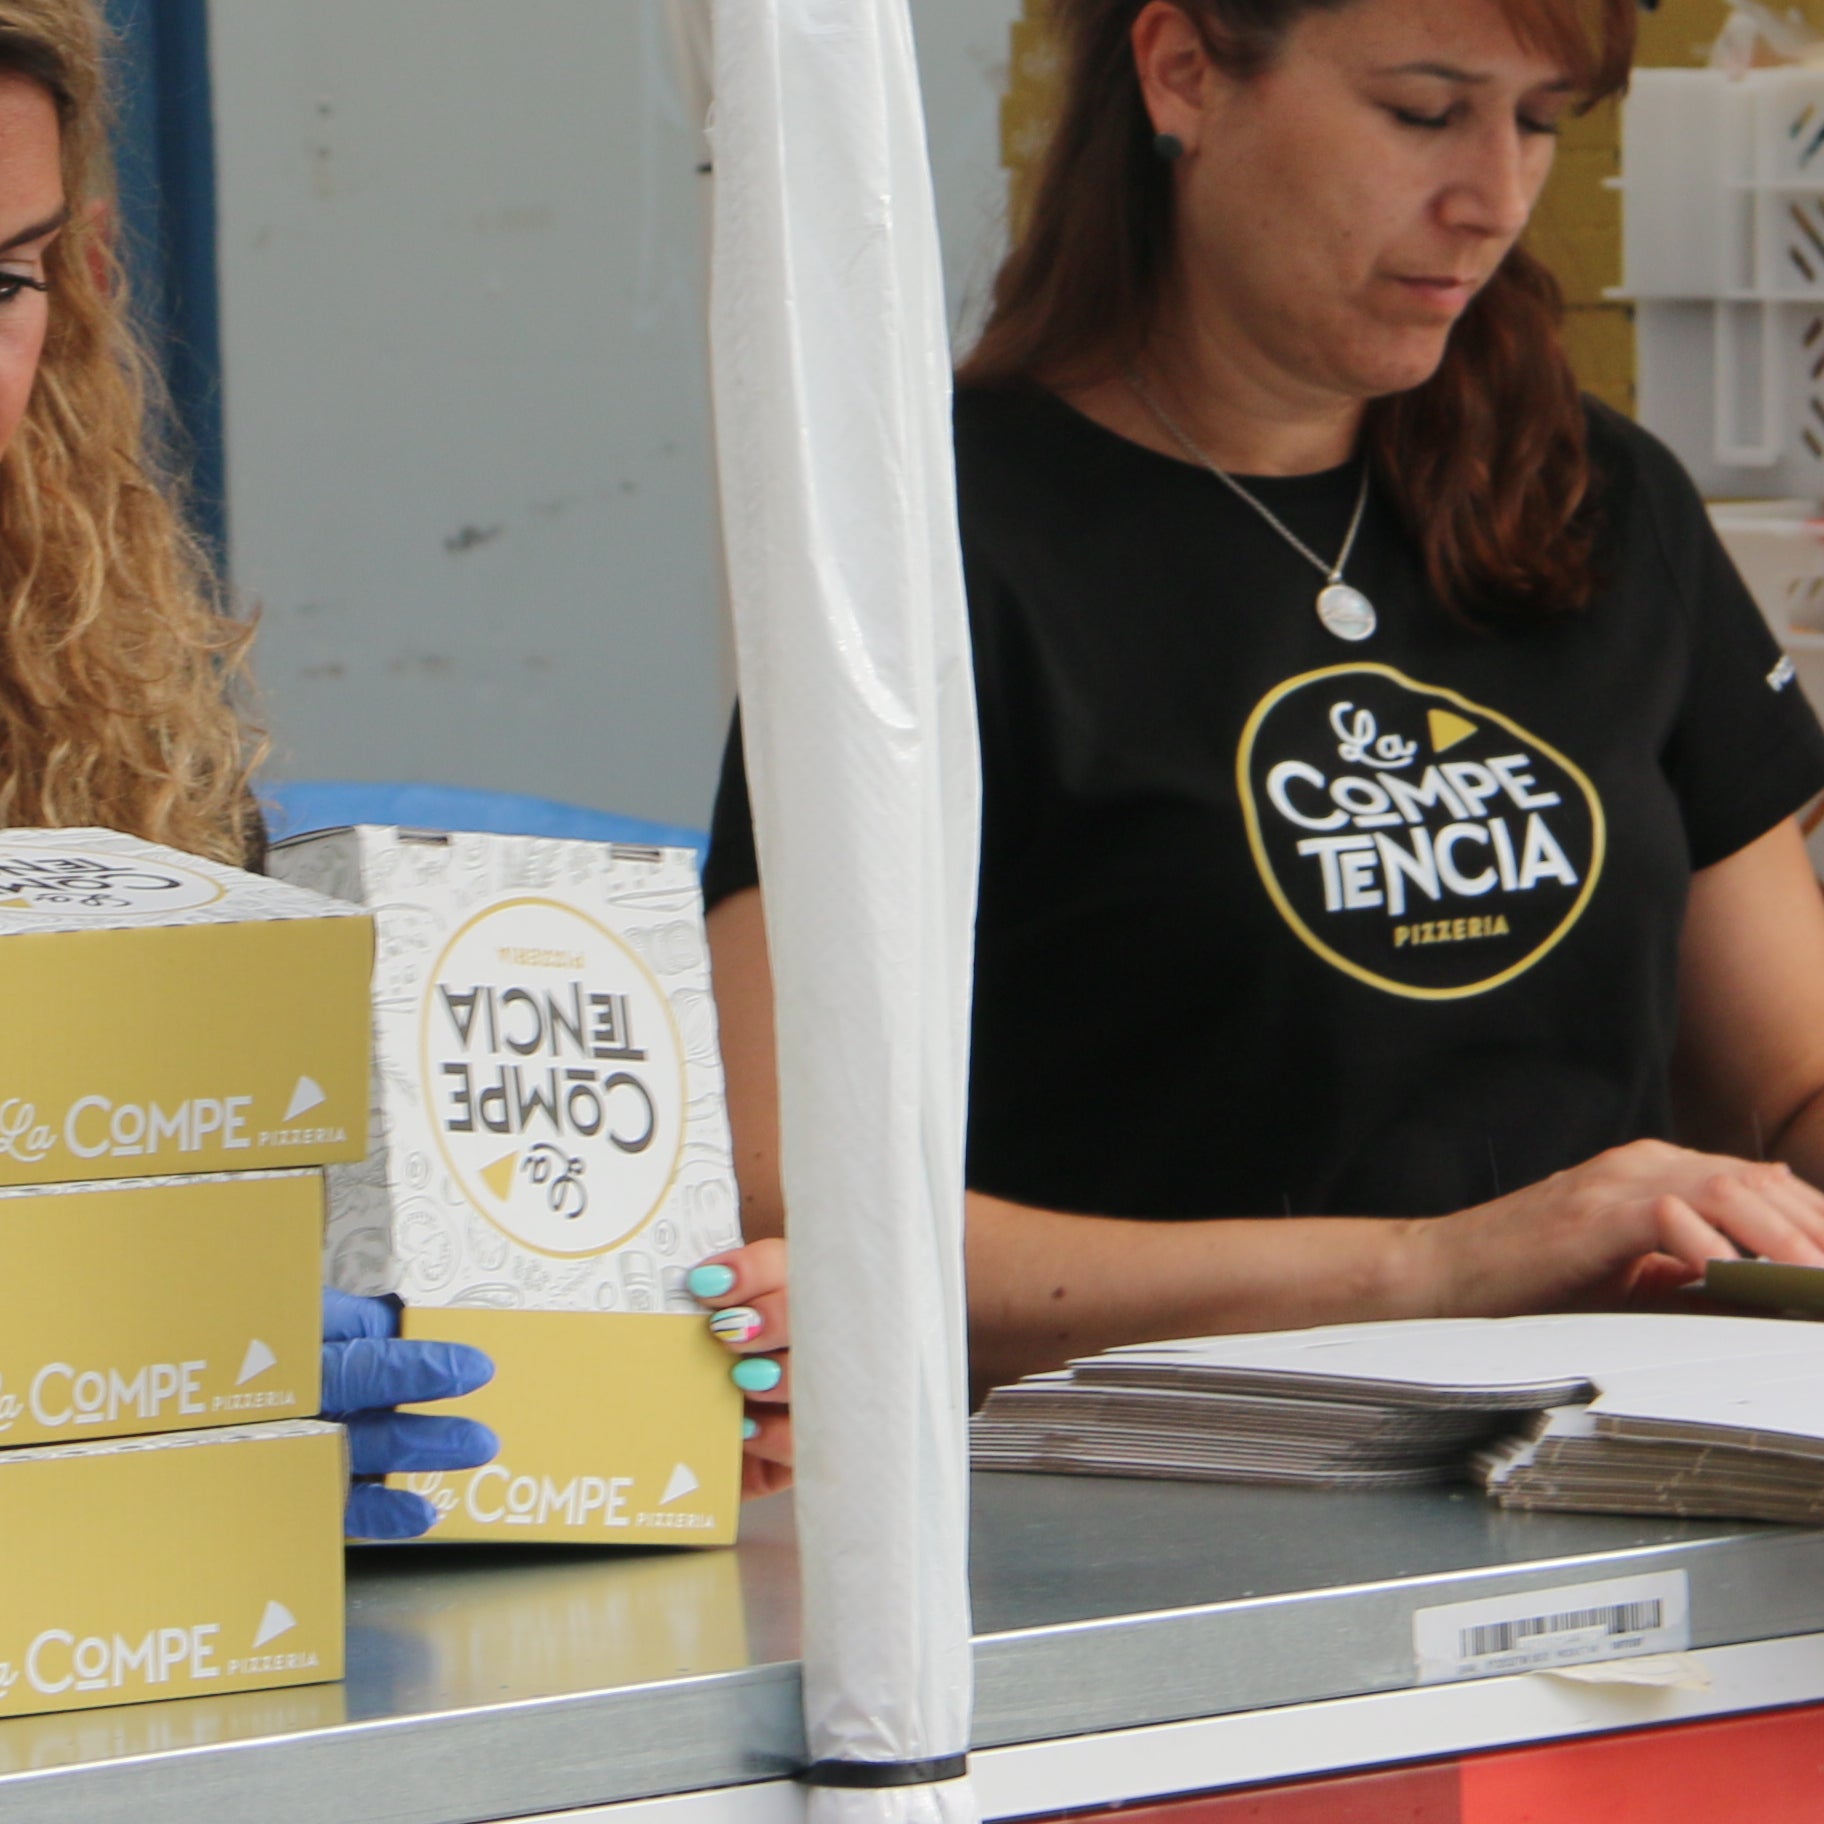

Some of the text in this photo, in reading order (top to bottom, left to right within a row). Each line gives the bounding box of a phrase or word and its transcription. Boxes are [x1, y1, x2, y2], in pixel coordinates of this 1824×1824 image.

[1330, 702, 1417, 767] La
[1266, 753, 1562, 831] COMPE
[1297, 813, 1578, 916] TENCIA
[496, 945, 585, 969] PIZZERIA
[1393, 915, 1509, 947] PIZZERIA
[437, 981, 650, 1061] TENCIA
[64, 1094, 253, 1159] COMPE
[258, 1127, 347, 1147] PIZZERIA
[440, 1062, 657, 1154] COMPE
[522, 1143, 587, 1220] La
[30, 1360, 207, 1423] COMPE
[212, 1390, 296, 1412] PIZZERIA
[465, 1464, 634, 1526] COMPE
[635, 1513, 716, 1528] PIZZERIA
[25, 1623, 220, 1692] COMPE
[228, 1651, 320, 1675] PIZZERIA
